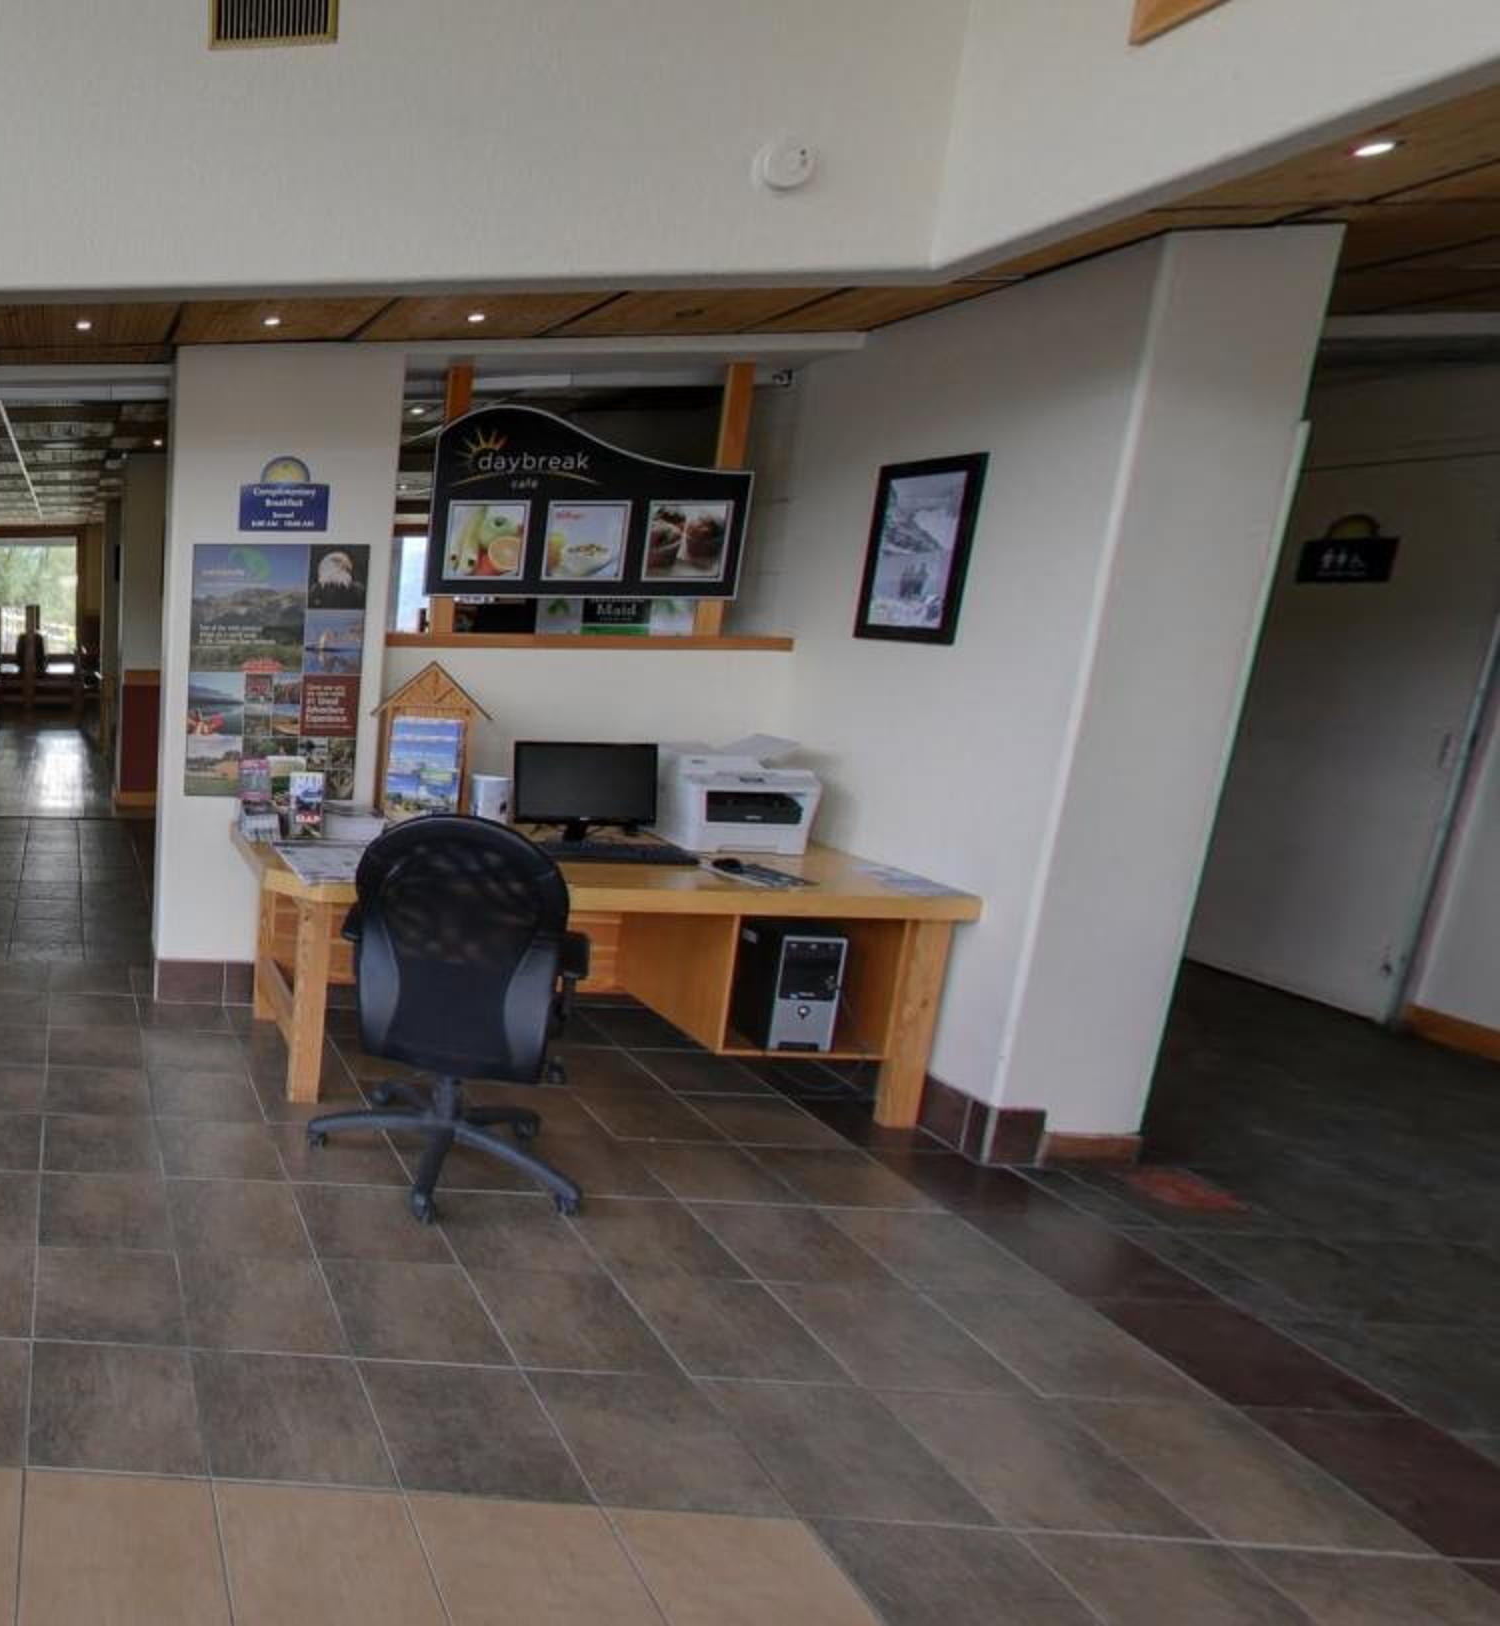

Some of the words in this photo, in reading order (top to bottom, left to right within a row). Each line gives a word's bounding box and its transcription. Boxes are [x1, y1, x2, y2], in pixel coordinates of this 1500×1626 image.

[478, 452, 590, 475] daybreak
[253, 488, 317, 499] Complimentary
[265, 498, 304, 507] Breakfast
[597, 603, 637, 616] Maid
